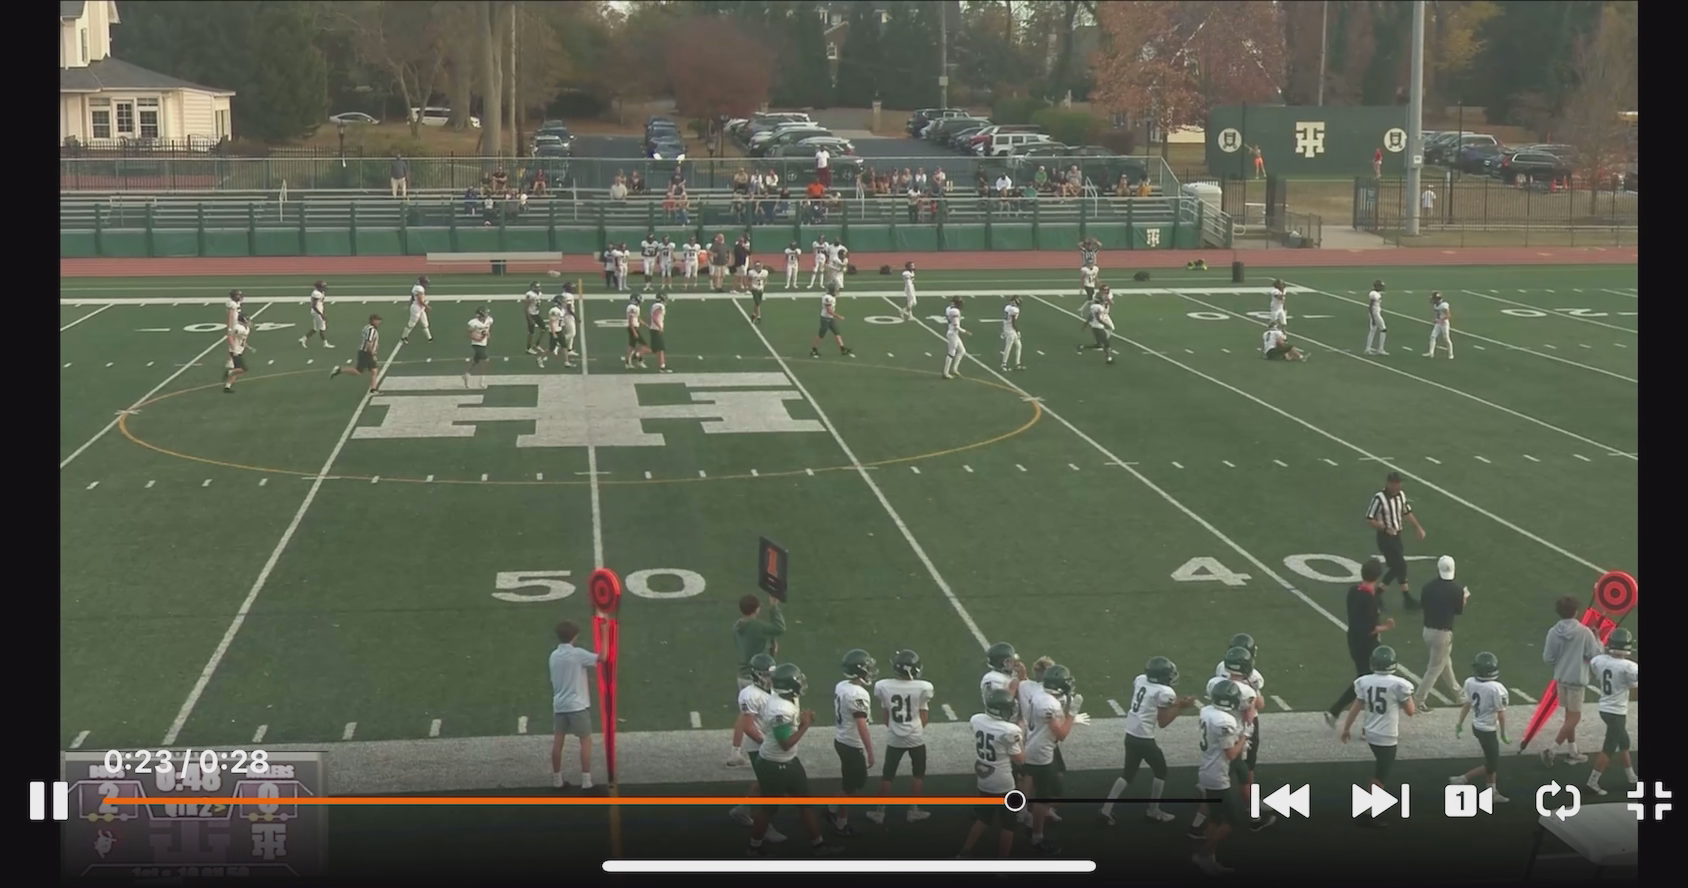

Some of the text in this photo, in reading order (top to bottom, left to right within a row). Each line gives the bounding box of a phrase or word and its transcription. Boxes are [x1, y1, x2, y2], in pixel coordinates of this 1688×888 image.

[1170, 553, 1363, 586] 40
[491, 568, 706, 602] 50
[1603, 668, 1613, 695] 6
[891, 694, 912, 723] 21
[1133, 686, 1147, 712] 9
[1367, 686, 1387, 714] 15
[975, 730, 997, 762] 25
